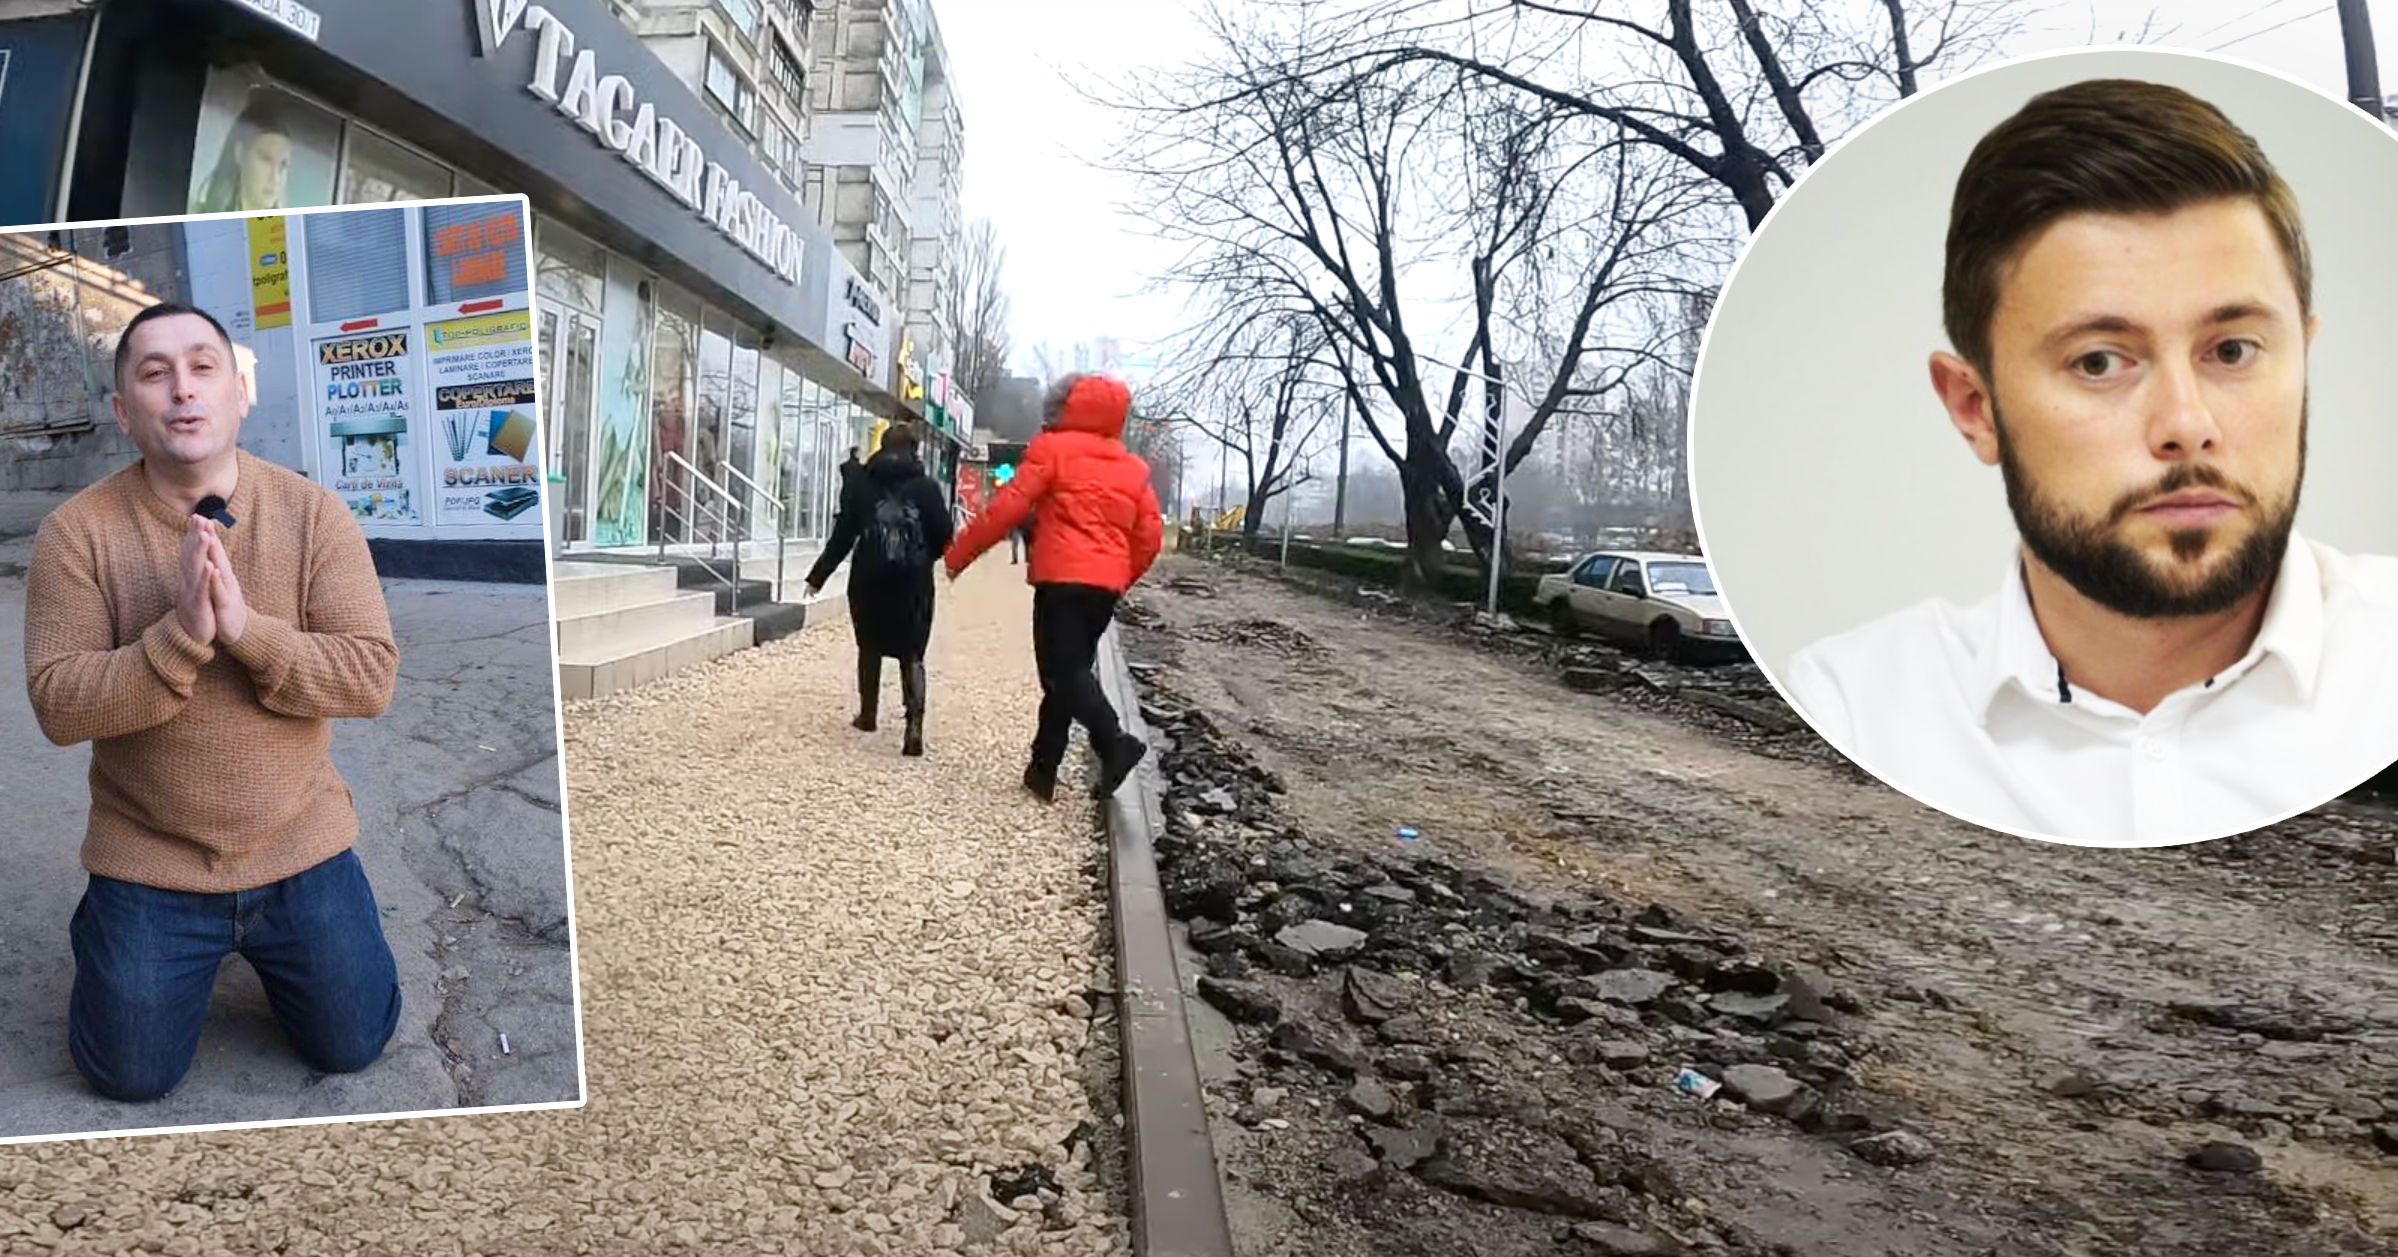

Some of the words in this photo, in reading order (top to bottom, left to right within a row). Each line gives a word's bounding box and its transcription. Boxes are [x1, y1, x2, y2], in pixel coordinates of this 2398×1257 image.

[704, 162, 804, 286] FASHION
[321, 334, 406, 365] XEROX
[477, 350, 506, 360] COLOR
[331, 361, 396, 381] PRINTER
[439, 364, 480, 374] LAMINARE
[467, 370, 506, 381] SCANARE
[327, 378, 402, 400] PLOTTER
[361, 480, 374, 489] de
[444, 465, 538, 486] SCANER
